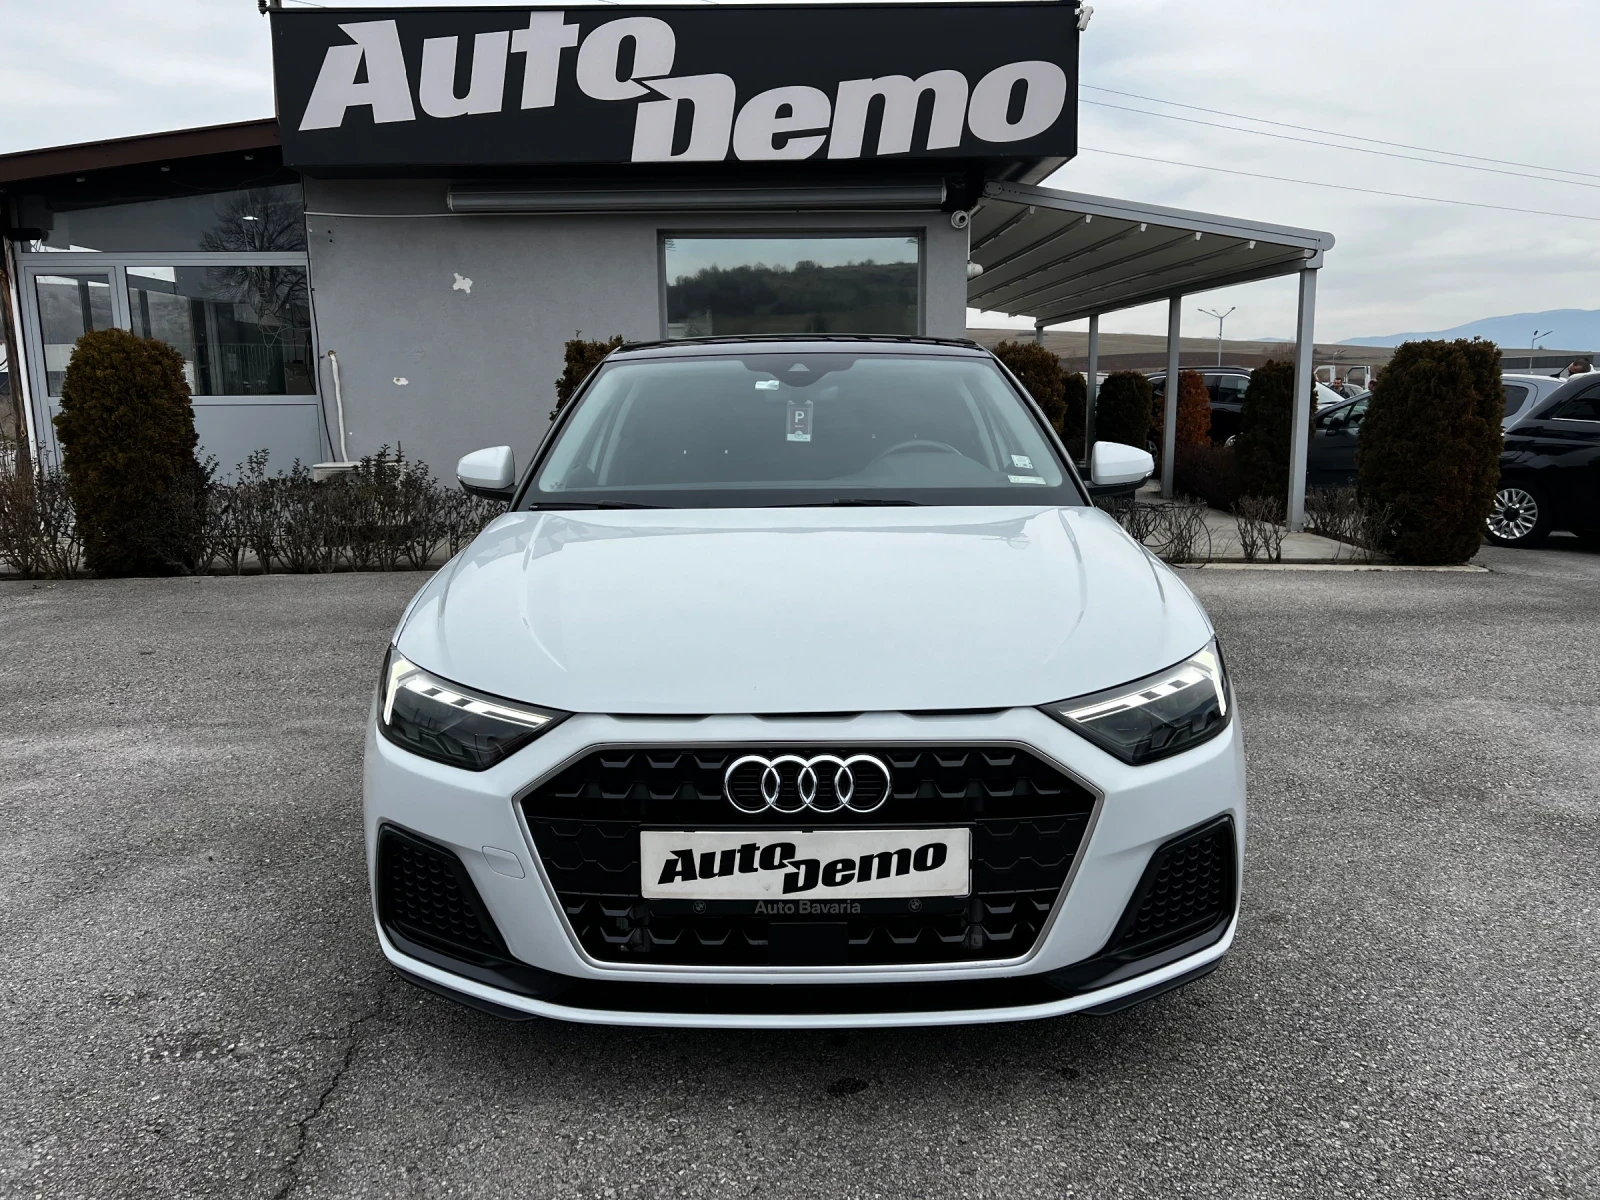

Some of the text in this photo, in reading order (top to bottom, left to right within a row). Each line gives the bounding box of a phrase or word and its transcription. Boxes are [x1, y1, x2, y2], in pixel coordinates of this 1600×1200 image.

[299, 11, 1067, 162] Auto Demo
[794, 410, 805, 423] P
[657, 842, 948, 894] Auto Demo
[754, 899, 861, 914] Auto Bavaria
